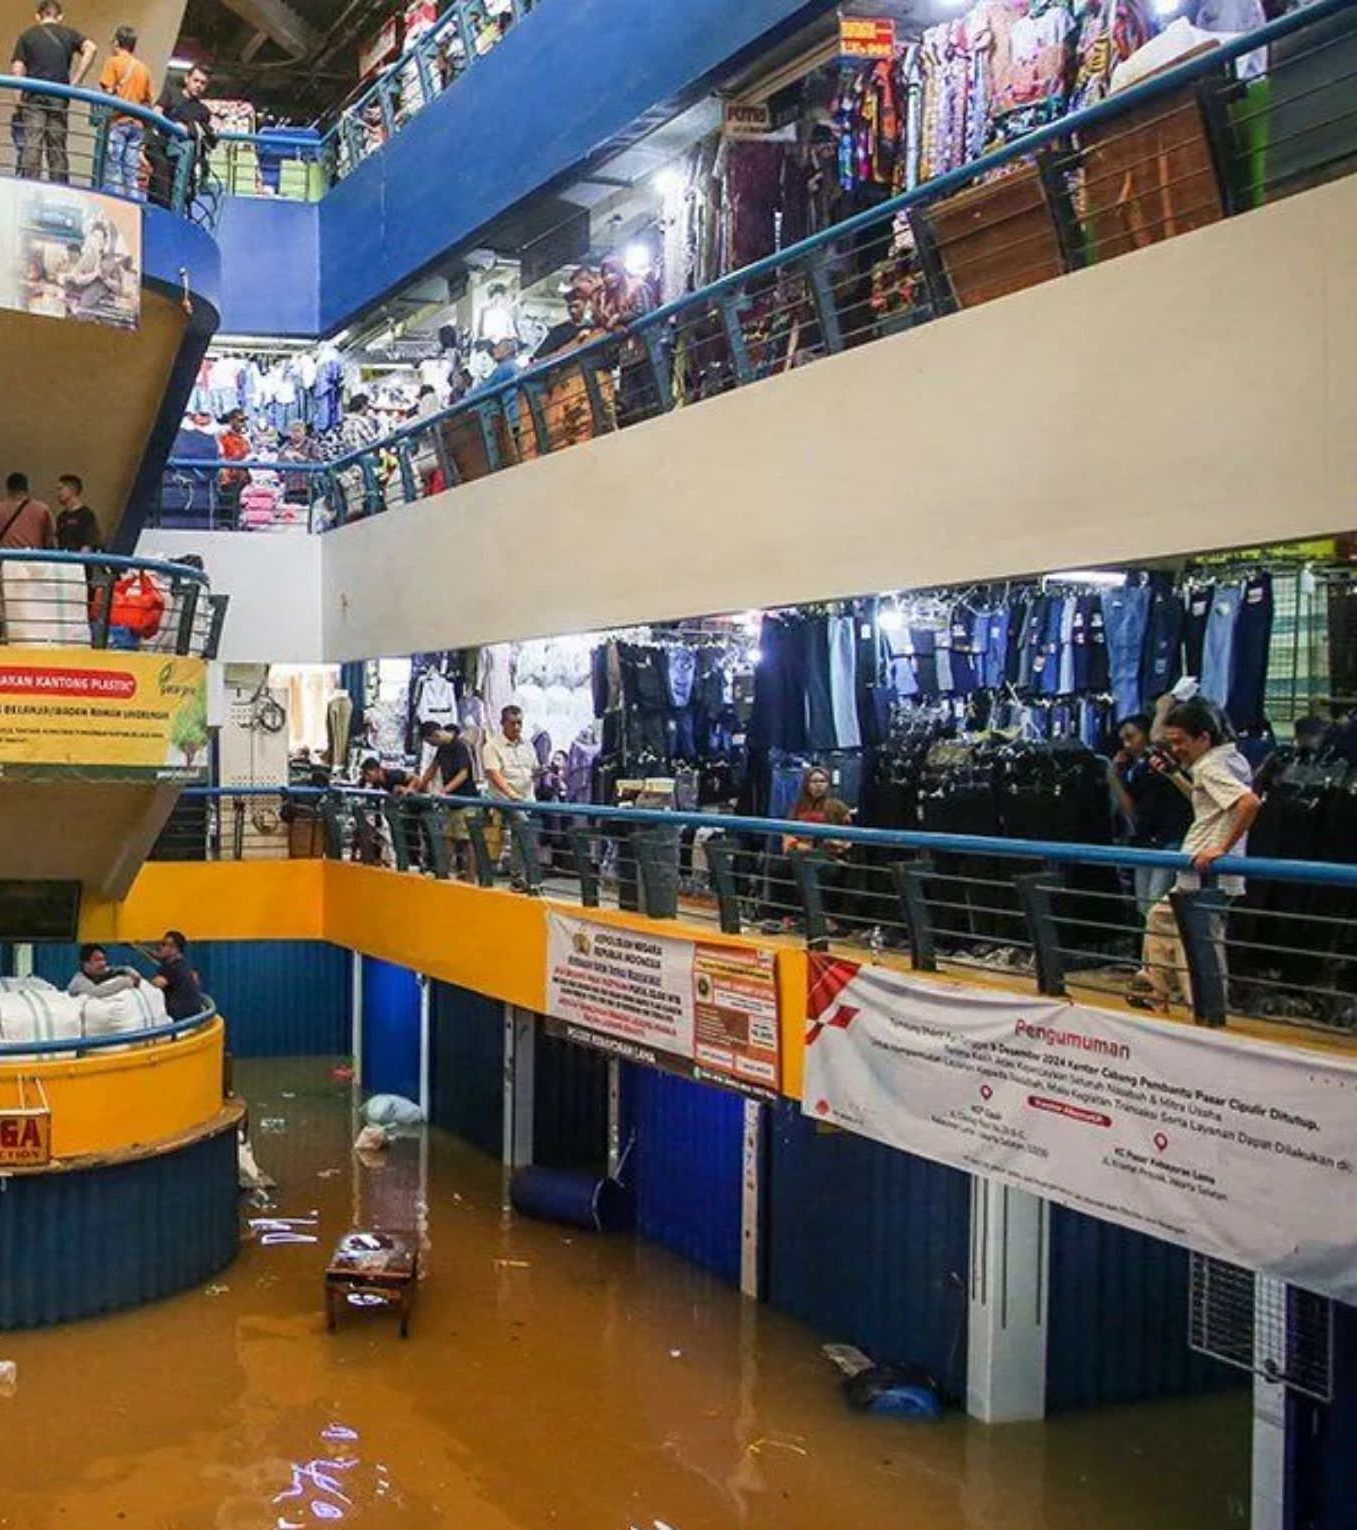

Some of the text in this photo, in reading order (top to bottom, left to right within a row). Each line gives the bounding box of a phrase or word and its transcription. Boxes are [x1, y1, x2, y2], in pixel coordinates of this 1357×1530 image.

[35, 675, 89, 689] KANTONG
[1015, 1019, 1130, 1060] Pengumuman
[999, 1043, 1041, 1060] Desember
[1042, 1053, 1066, 1067] 2024
[1067, 1060, 1099, 1075] Kantor
[1101, 1067, 1138, 1087] Cabang
[1140, 1076, 1192, 1099] Pembantu
[1195, 1089, 1226, 1106] Pasar
[1228, 1098, 1267, 1117] Cipulir
[1114, 1100, 1157, 1120] Transaksi
[1160, 1111, 1188, 1128] Serta
[1190, 1120, 1235, 1141] Layanan
[1237, 1132, 1272, 1151] Dapat
[1274, 1141, 1335, 1168] Dilakukan
